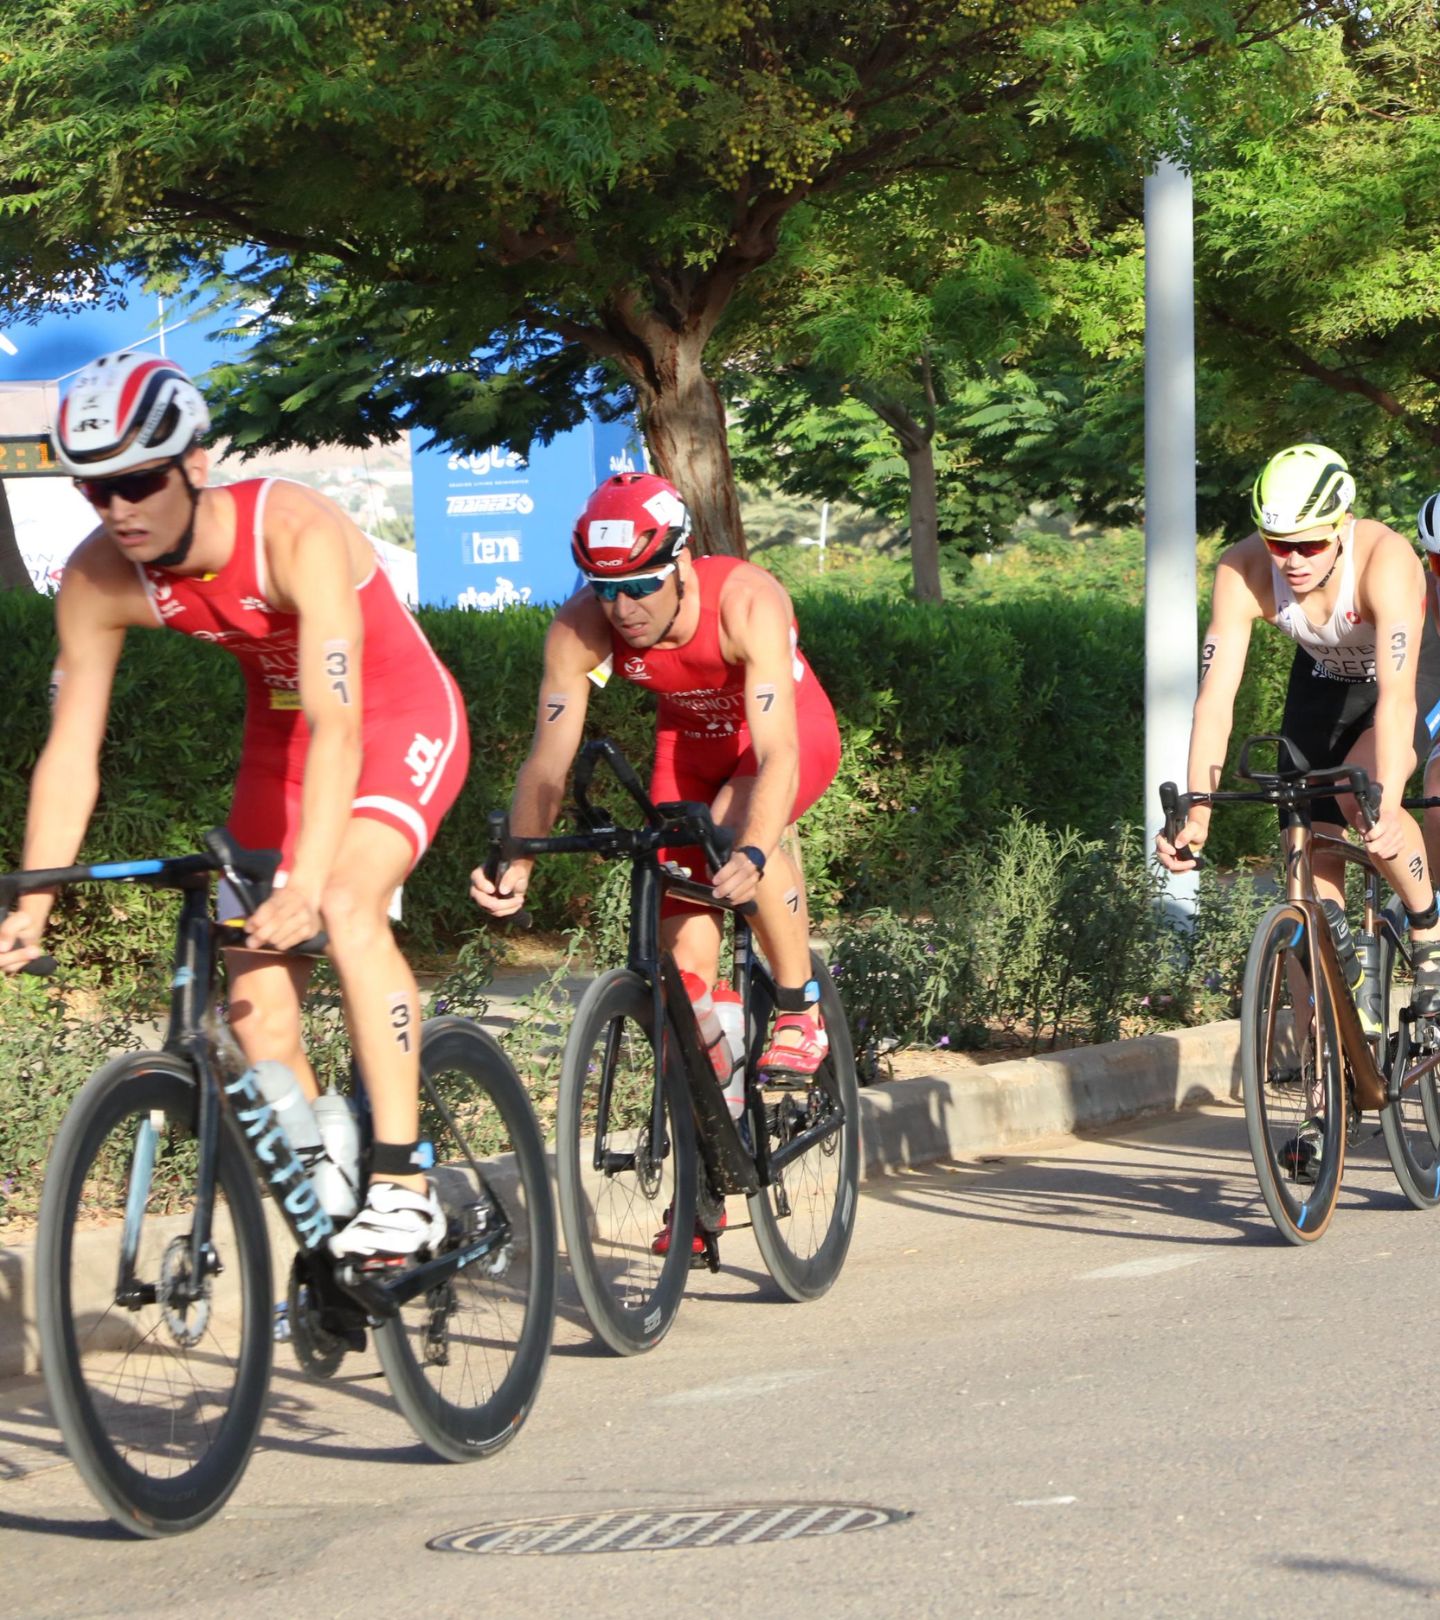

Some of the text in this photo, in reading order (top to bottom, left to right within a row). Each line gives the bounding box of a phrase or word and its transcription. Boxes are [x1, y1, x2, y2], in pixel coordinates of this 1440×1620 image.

[1265, 513, 1278, 525] 37
[600, 527, 608, 540] 7
[1391, 632, 1406, 671] 37
[326, 652, 348, 703] 31
[547, 703, 565, 721] 7
[756, 693, 774, 712] 7
[787, 895, 798, 913] 7
[391, 1004, 411, 1051] 31
[225, 1069, 334, 1248] FACTOR
